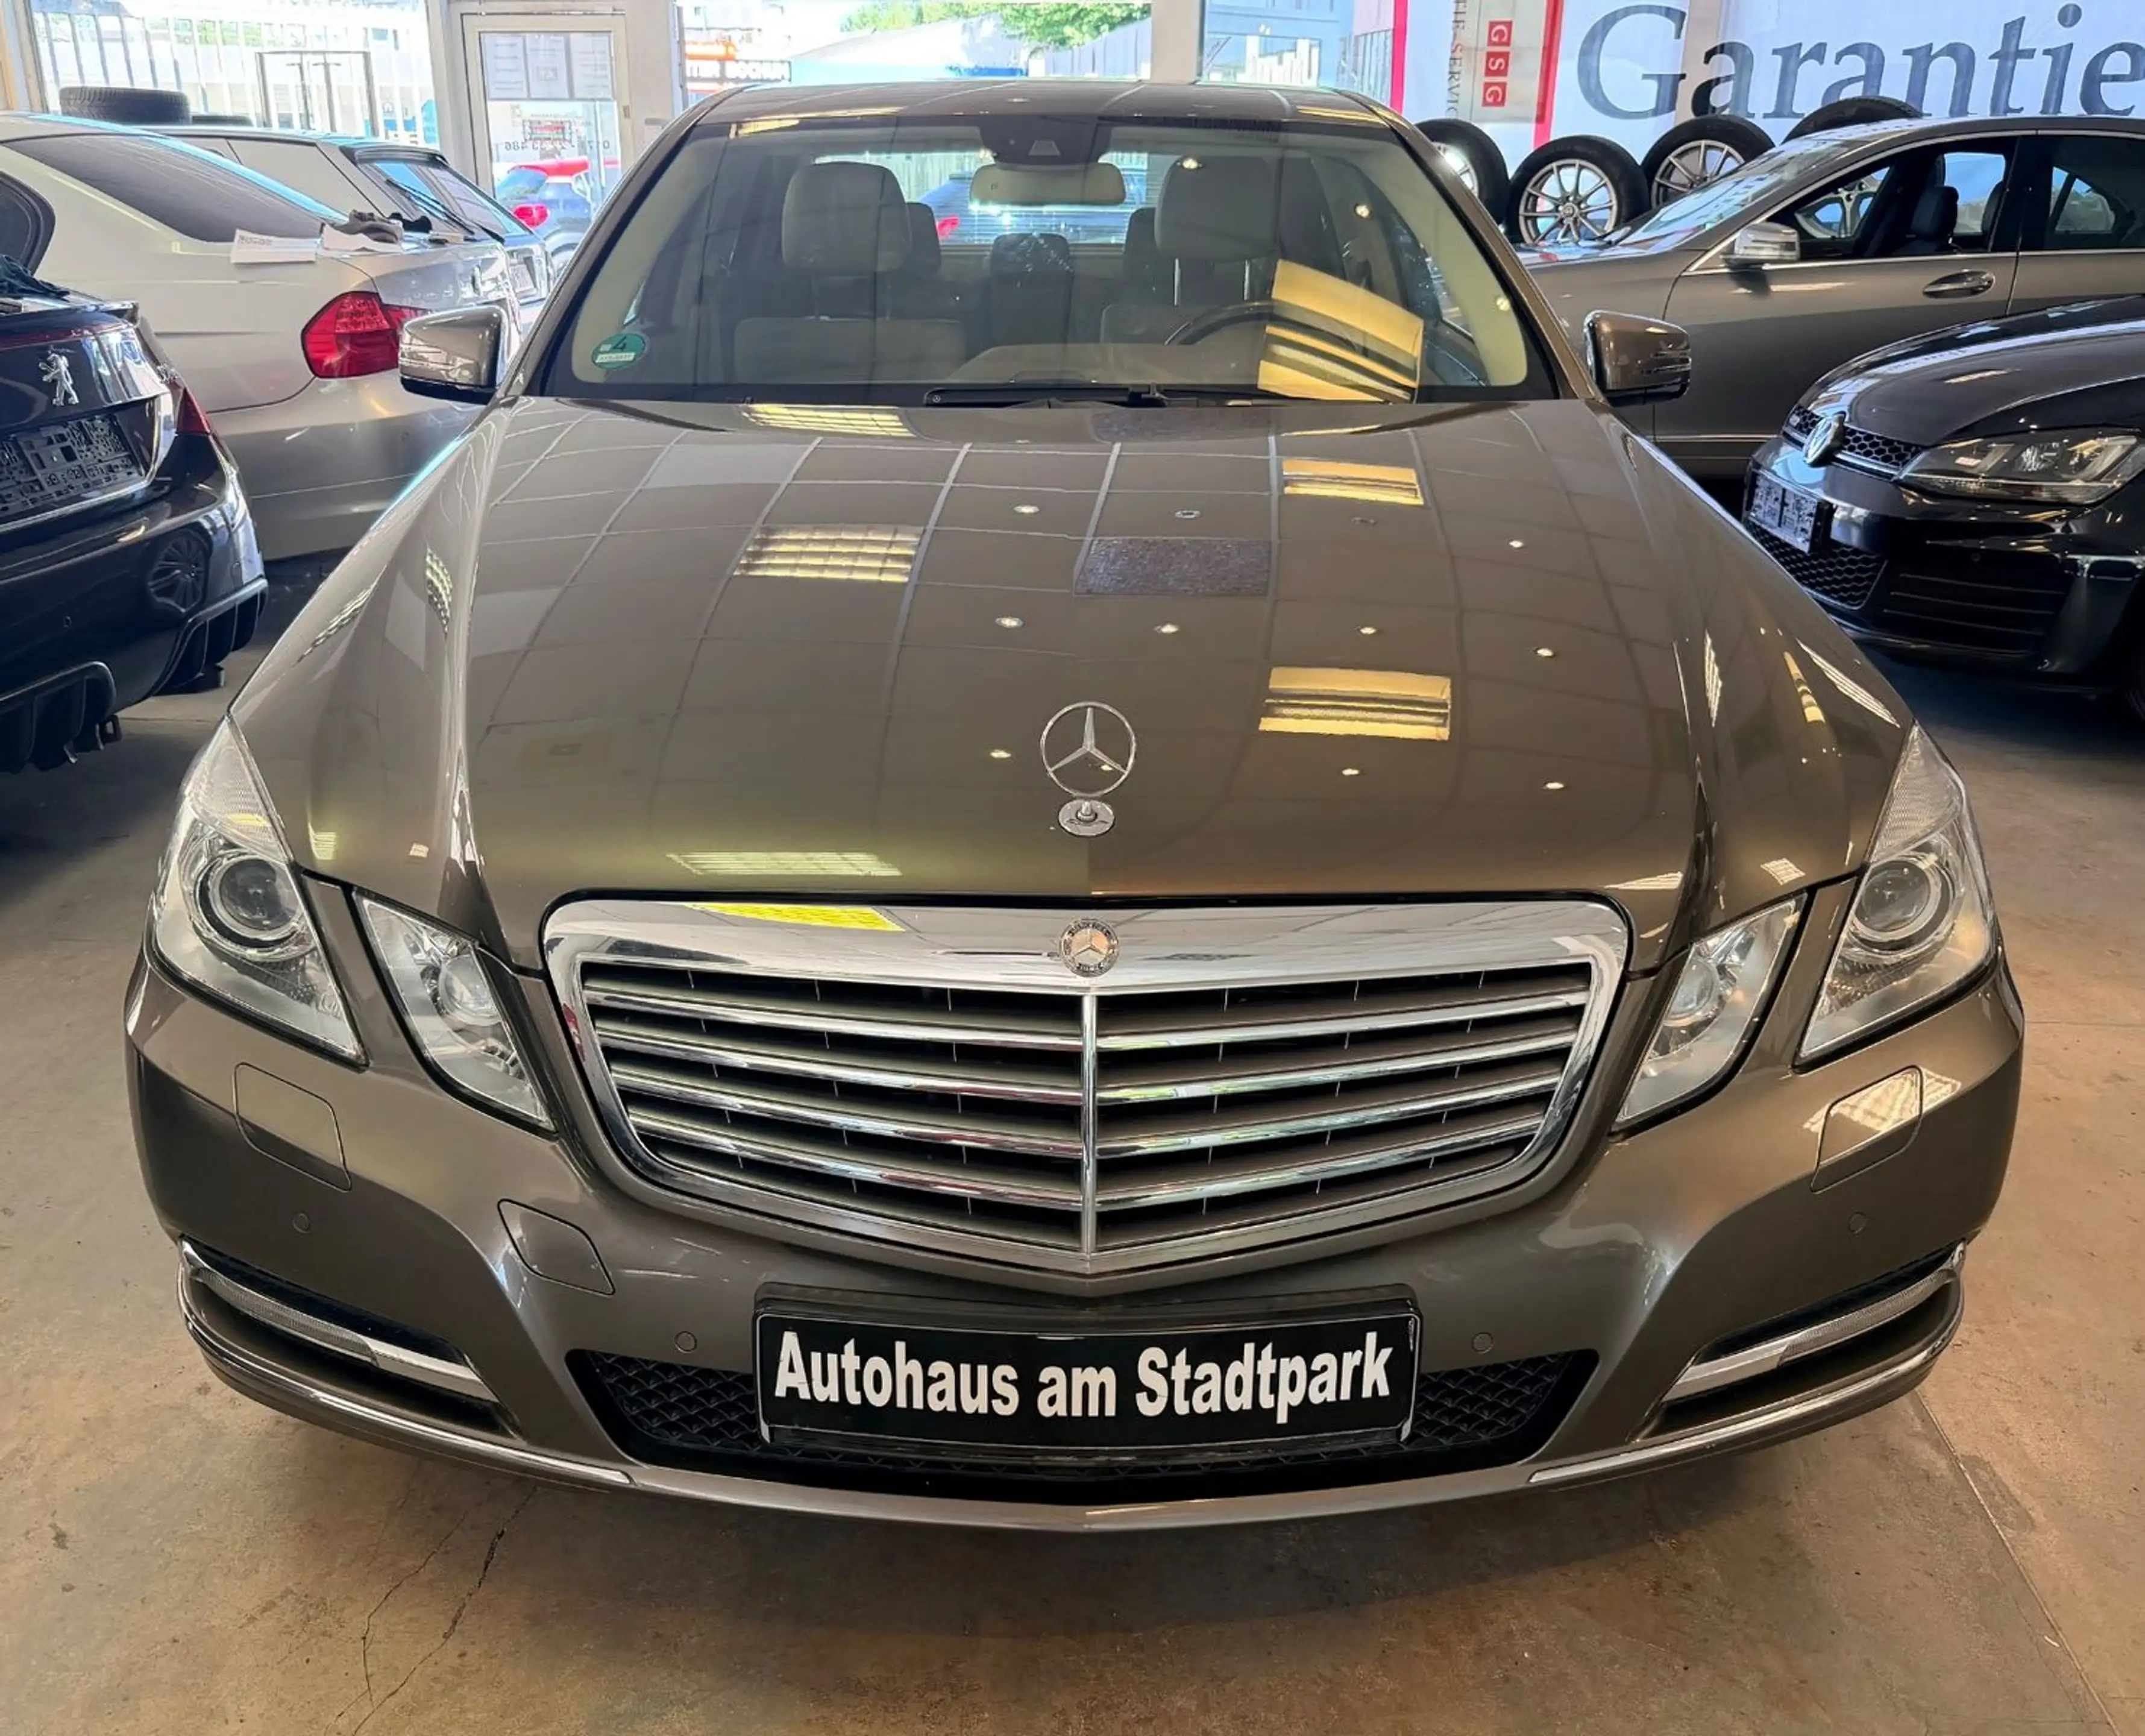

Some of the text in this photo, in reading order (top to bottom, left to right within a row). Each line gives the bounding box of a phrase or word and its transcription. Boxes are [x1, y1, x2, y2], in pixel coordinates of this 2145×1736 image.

[1485, 25, 1507, 102] GSG
[1577, 3, 2145, 119] Garantie
[613, 335, 627, 352] 4
[774, 1331, 1393, 1424] Autohaus am Stadtpark
